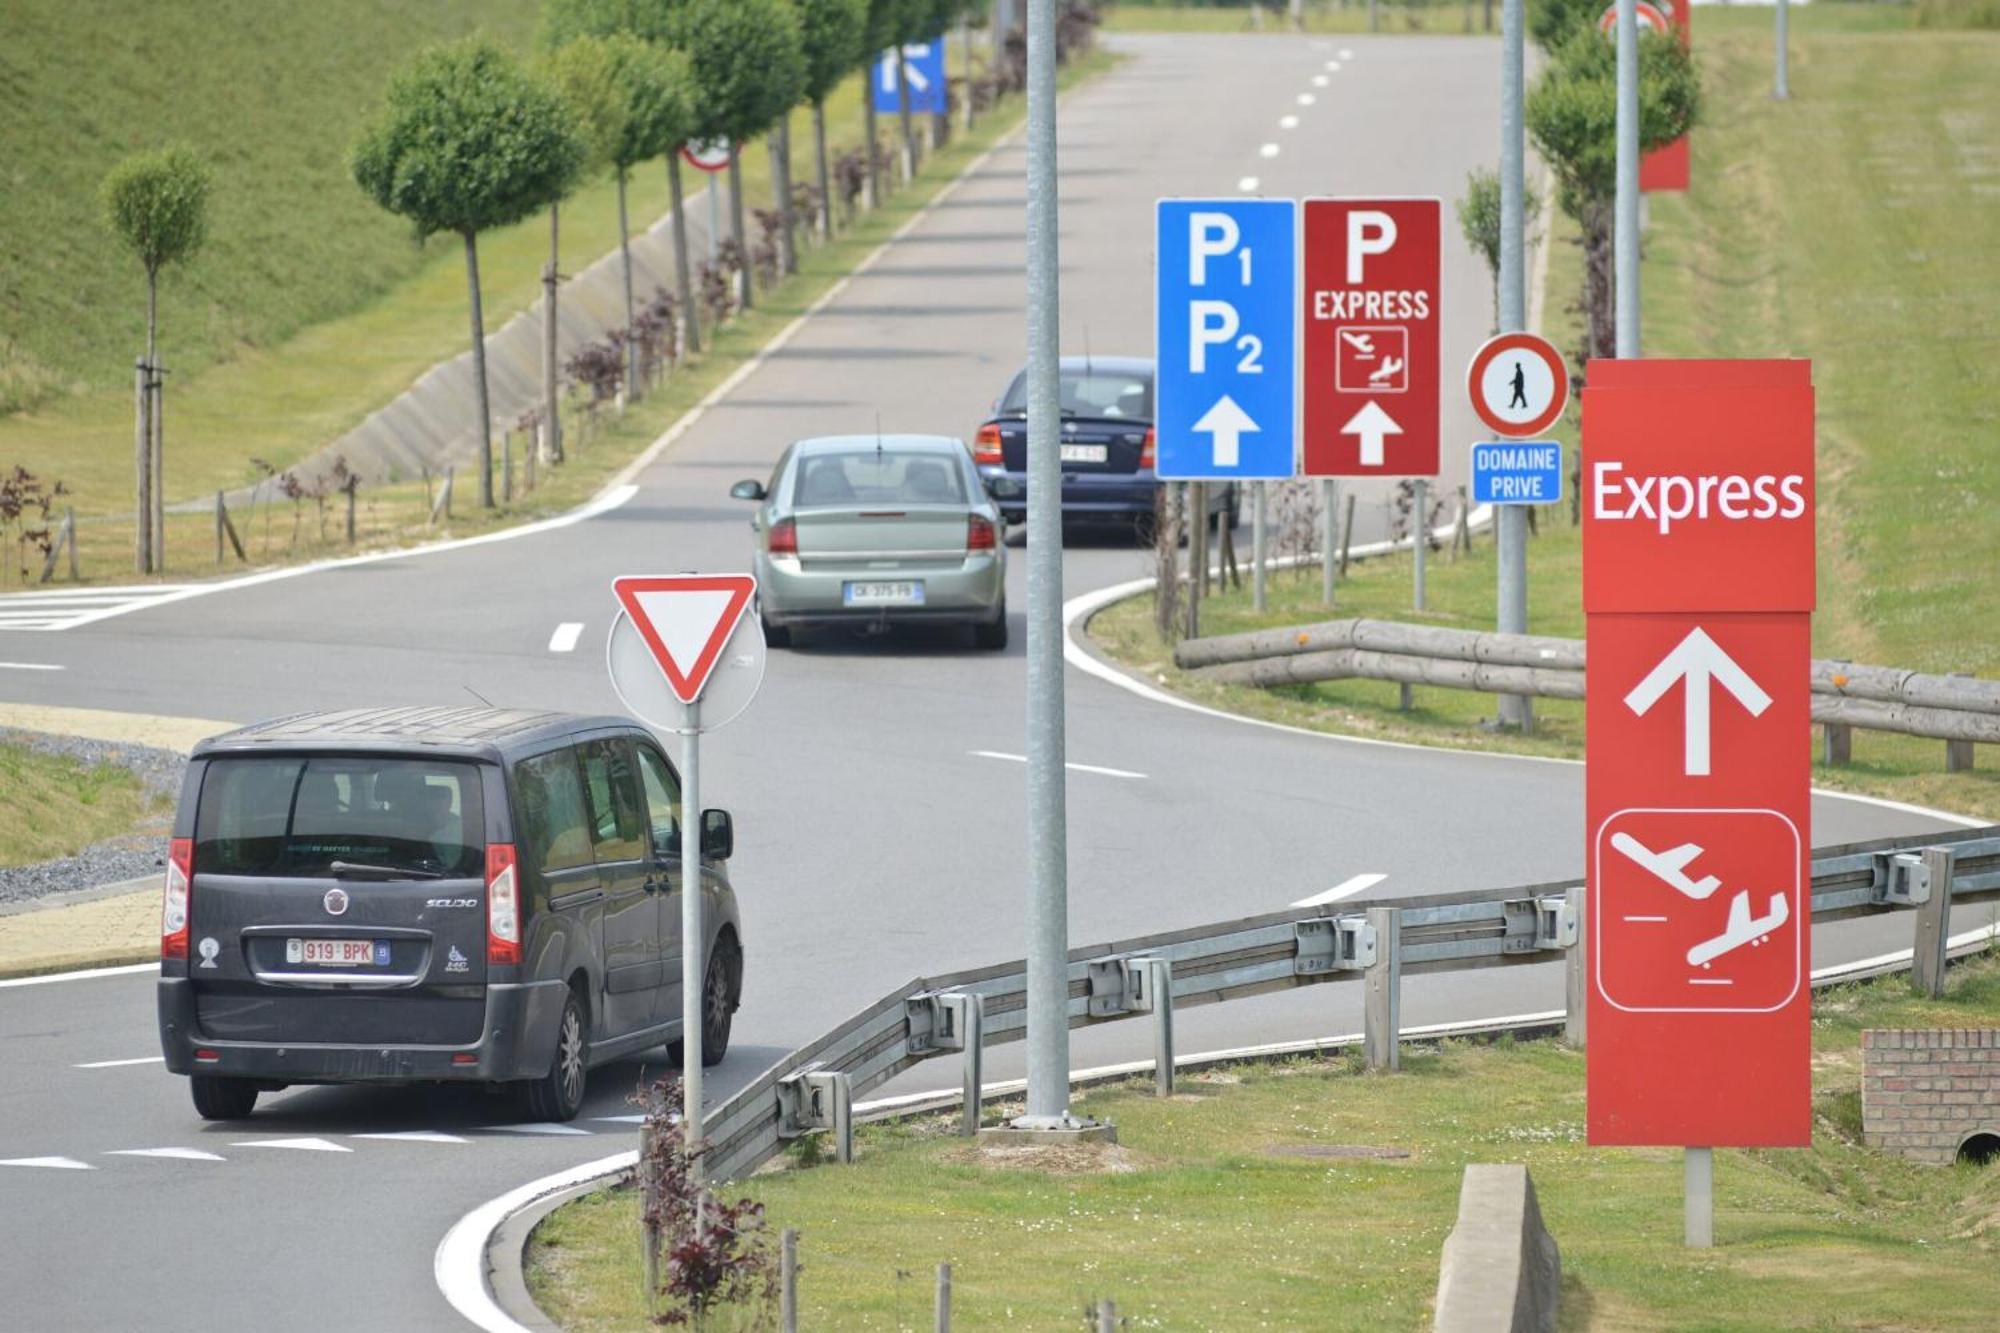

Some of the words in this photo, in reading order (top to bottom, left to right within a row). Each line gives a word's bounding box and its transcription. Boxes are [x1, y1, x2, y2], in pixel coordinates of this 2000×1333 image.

[1347, 210, 1397, 284] P
[1314, 290, 1429, 320] EXPRESS
[1477, 448, 1556, 470] DOMAINE
[1491, 476, 1543, 498] PRIVE
[1594, 461, 1805, 534] Express
